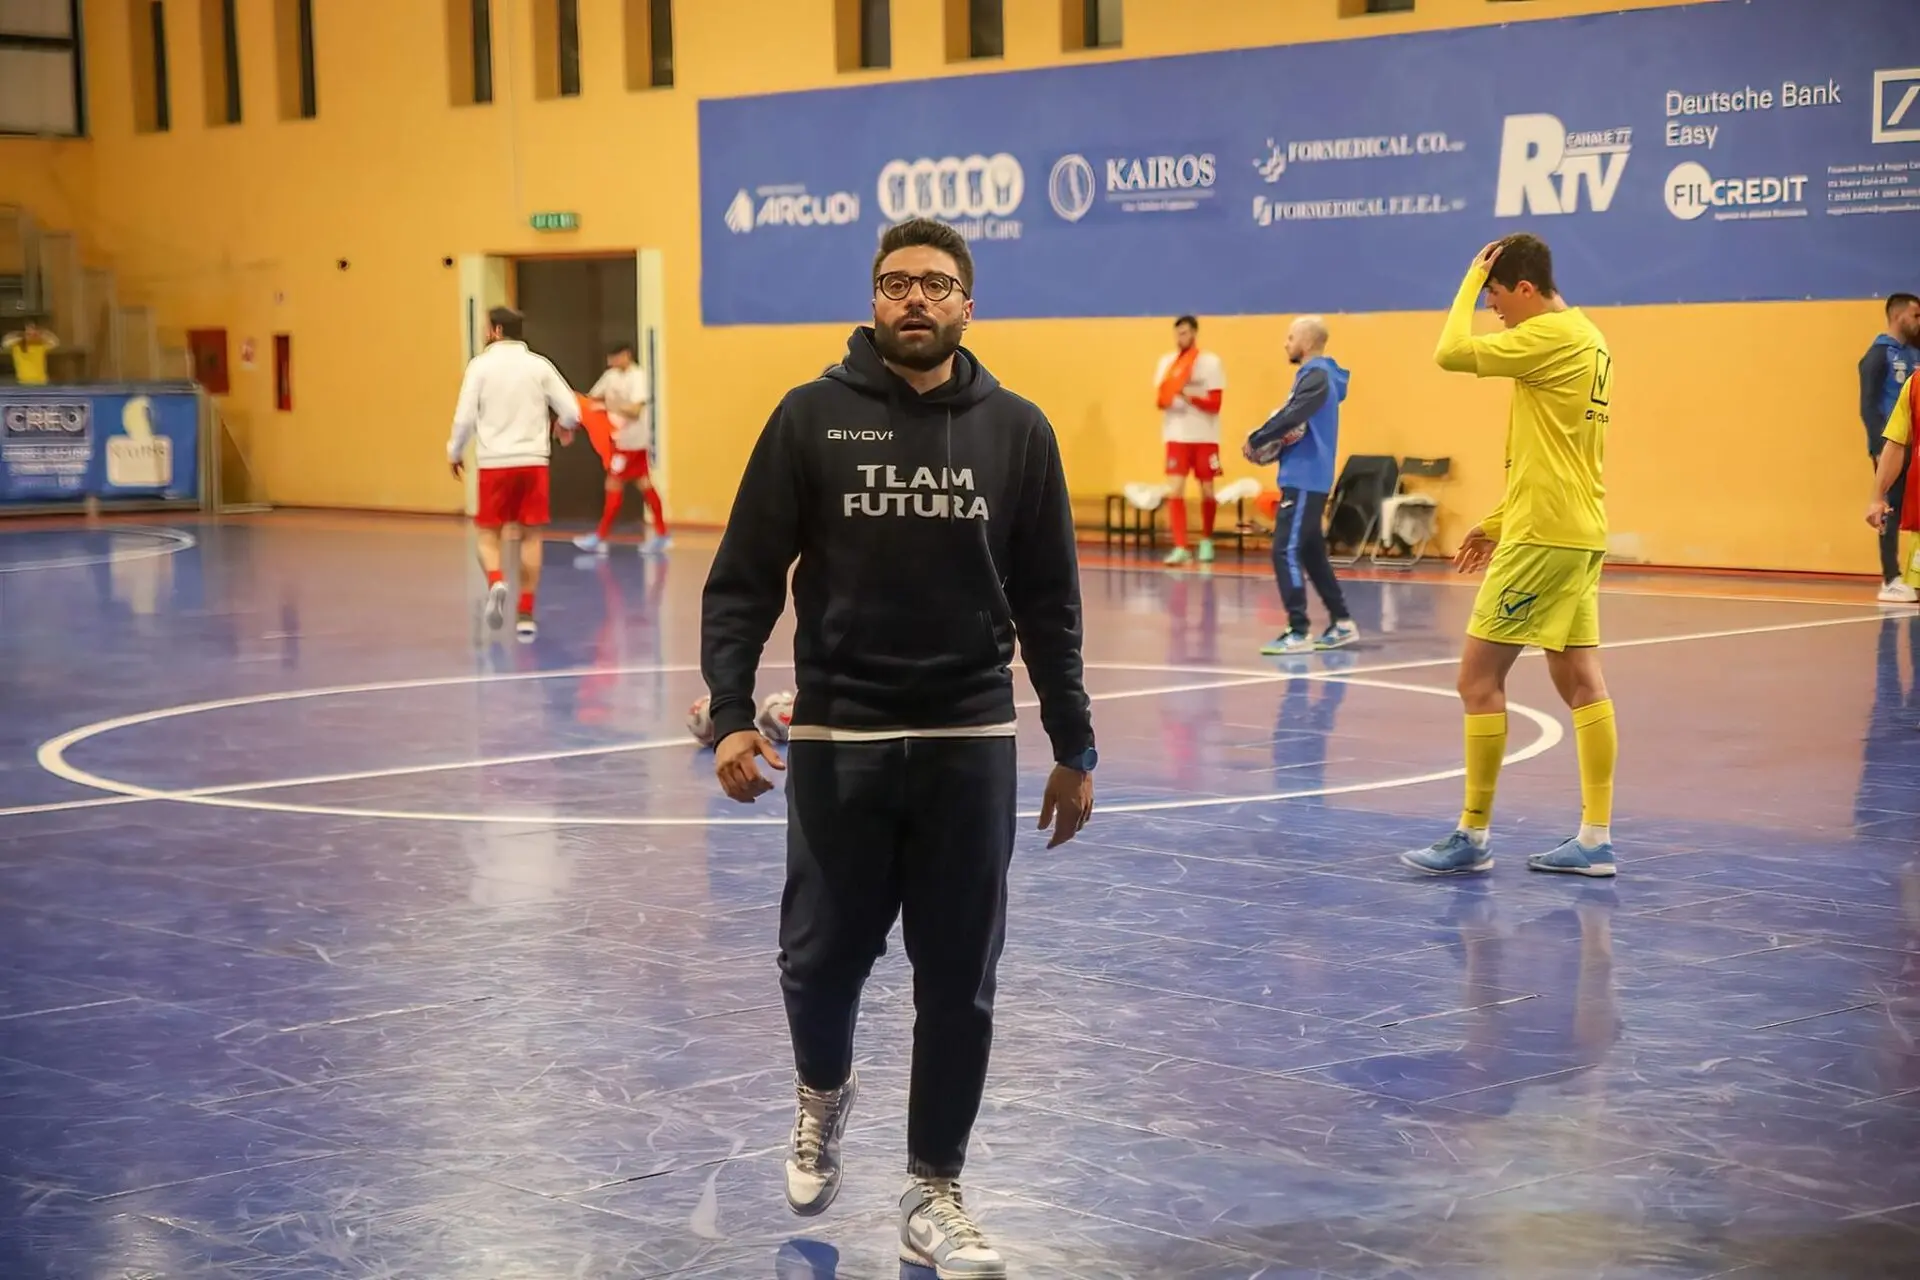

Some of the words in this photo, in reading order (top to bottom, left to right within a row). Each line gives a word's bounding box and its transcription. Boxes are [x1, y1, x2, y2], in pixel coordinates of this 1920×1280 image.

[1665, 85, 1773, 117] Deutsche
[1781, 78, 1842, 107] Bank
[1665, 119, 1719, 150] Easy
[1106, 153, 1216, 191] KAIROS
[844, 492, 990, 521] FUTURA
